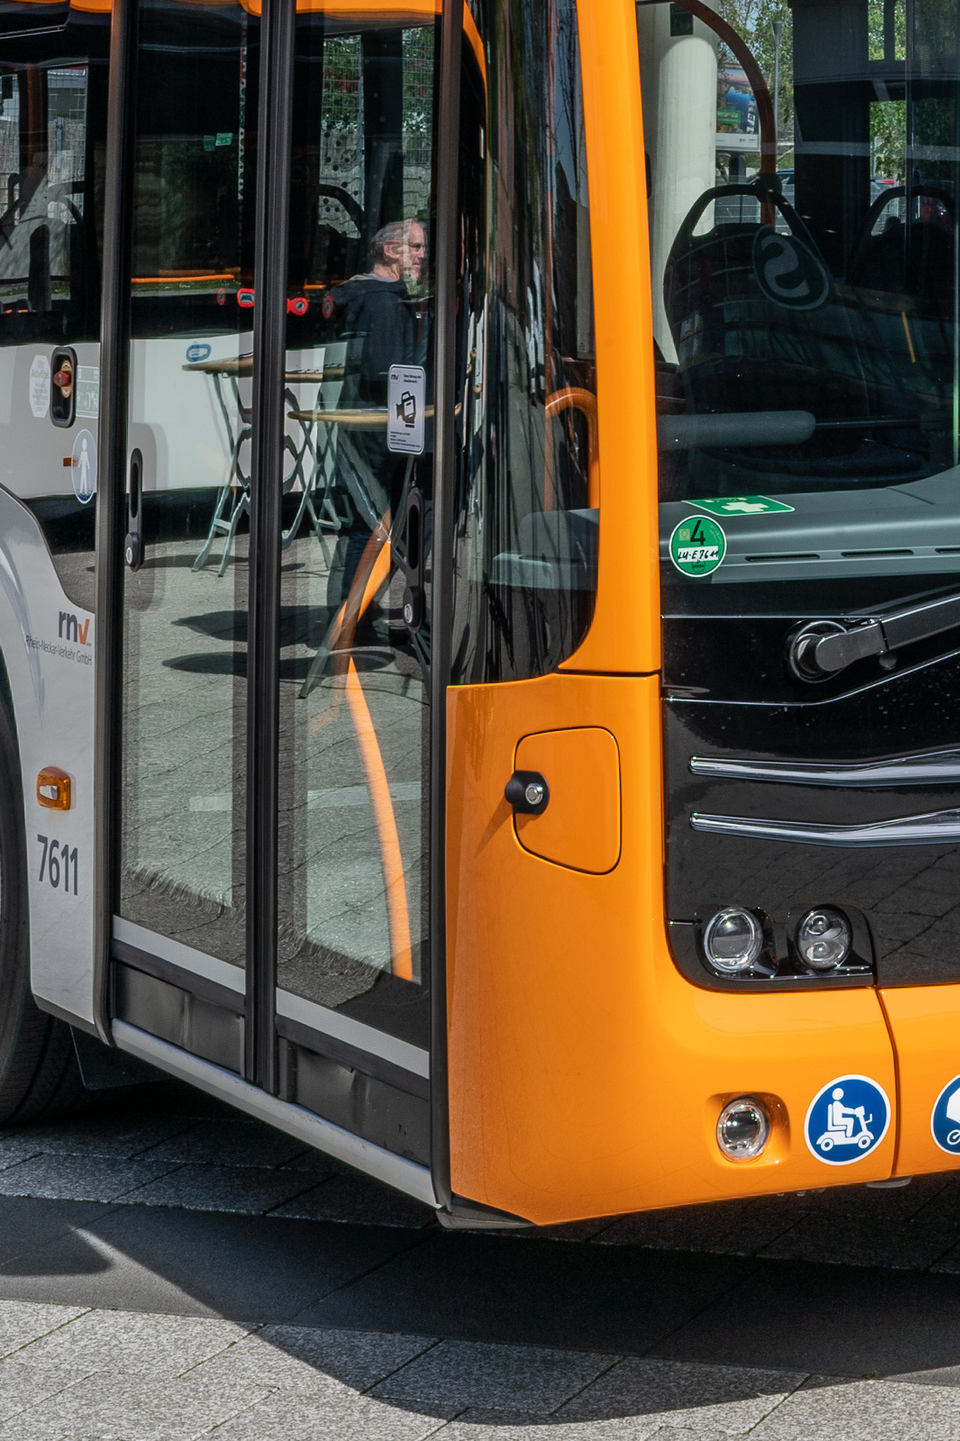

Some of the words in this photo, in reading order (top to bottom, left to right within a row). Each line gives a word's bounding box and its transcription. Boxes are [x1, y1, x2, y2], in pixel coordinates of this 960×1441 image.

[690, 519, 706, 546] 4
[58, 610, 91, 646] rnv
[36, 834, 79, 896] 7611
